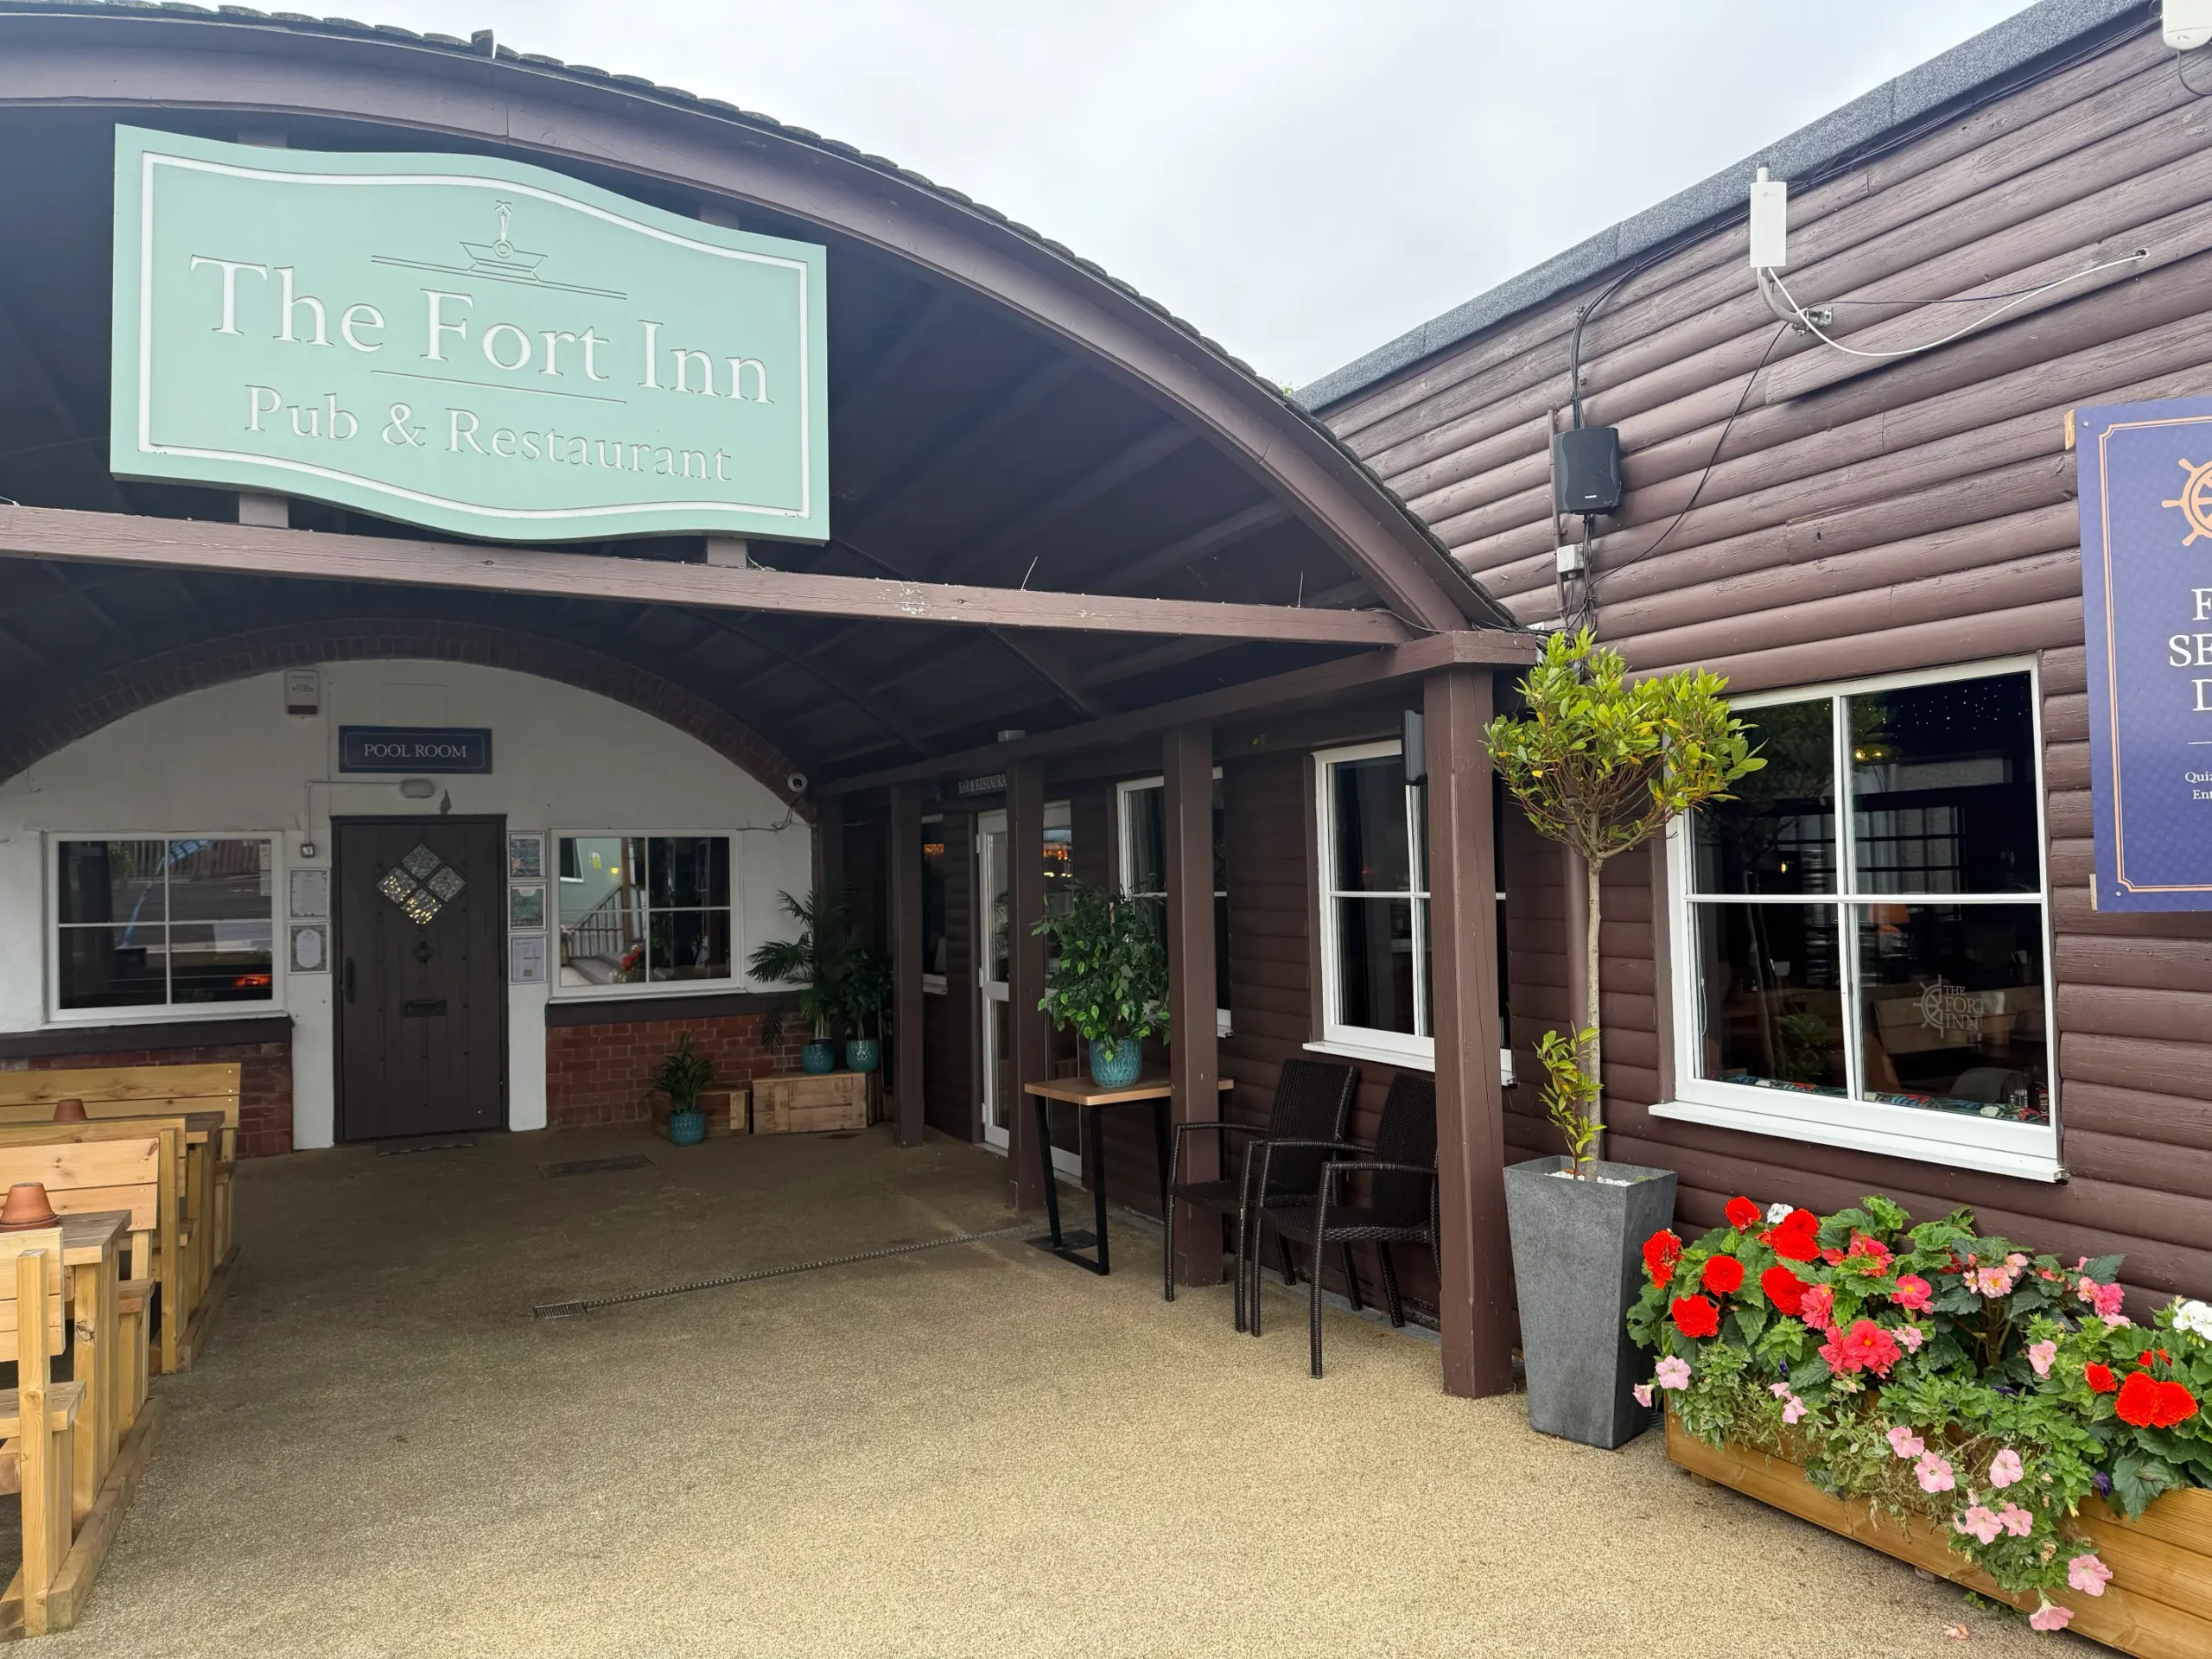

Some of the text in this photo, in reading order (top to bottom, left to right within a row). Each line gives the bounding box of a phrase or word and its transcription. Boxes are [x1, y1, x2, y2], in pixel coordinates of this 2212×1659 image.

[190, 254, 774, 404] The Fort Inn
[245, 384, 732, 482] Pub & Restaurant
[364, 743, 467, 758] POOL ROOM
[958, 774, 1007, 793] BAR & RESTAURA
[1943, 985, 1966, 995] THE
[1945, 996, 1985, 1014] FORT
[1945, 1013, 1980, 1031] INN
